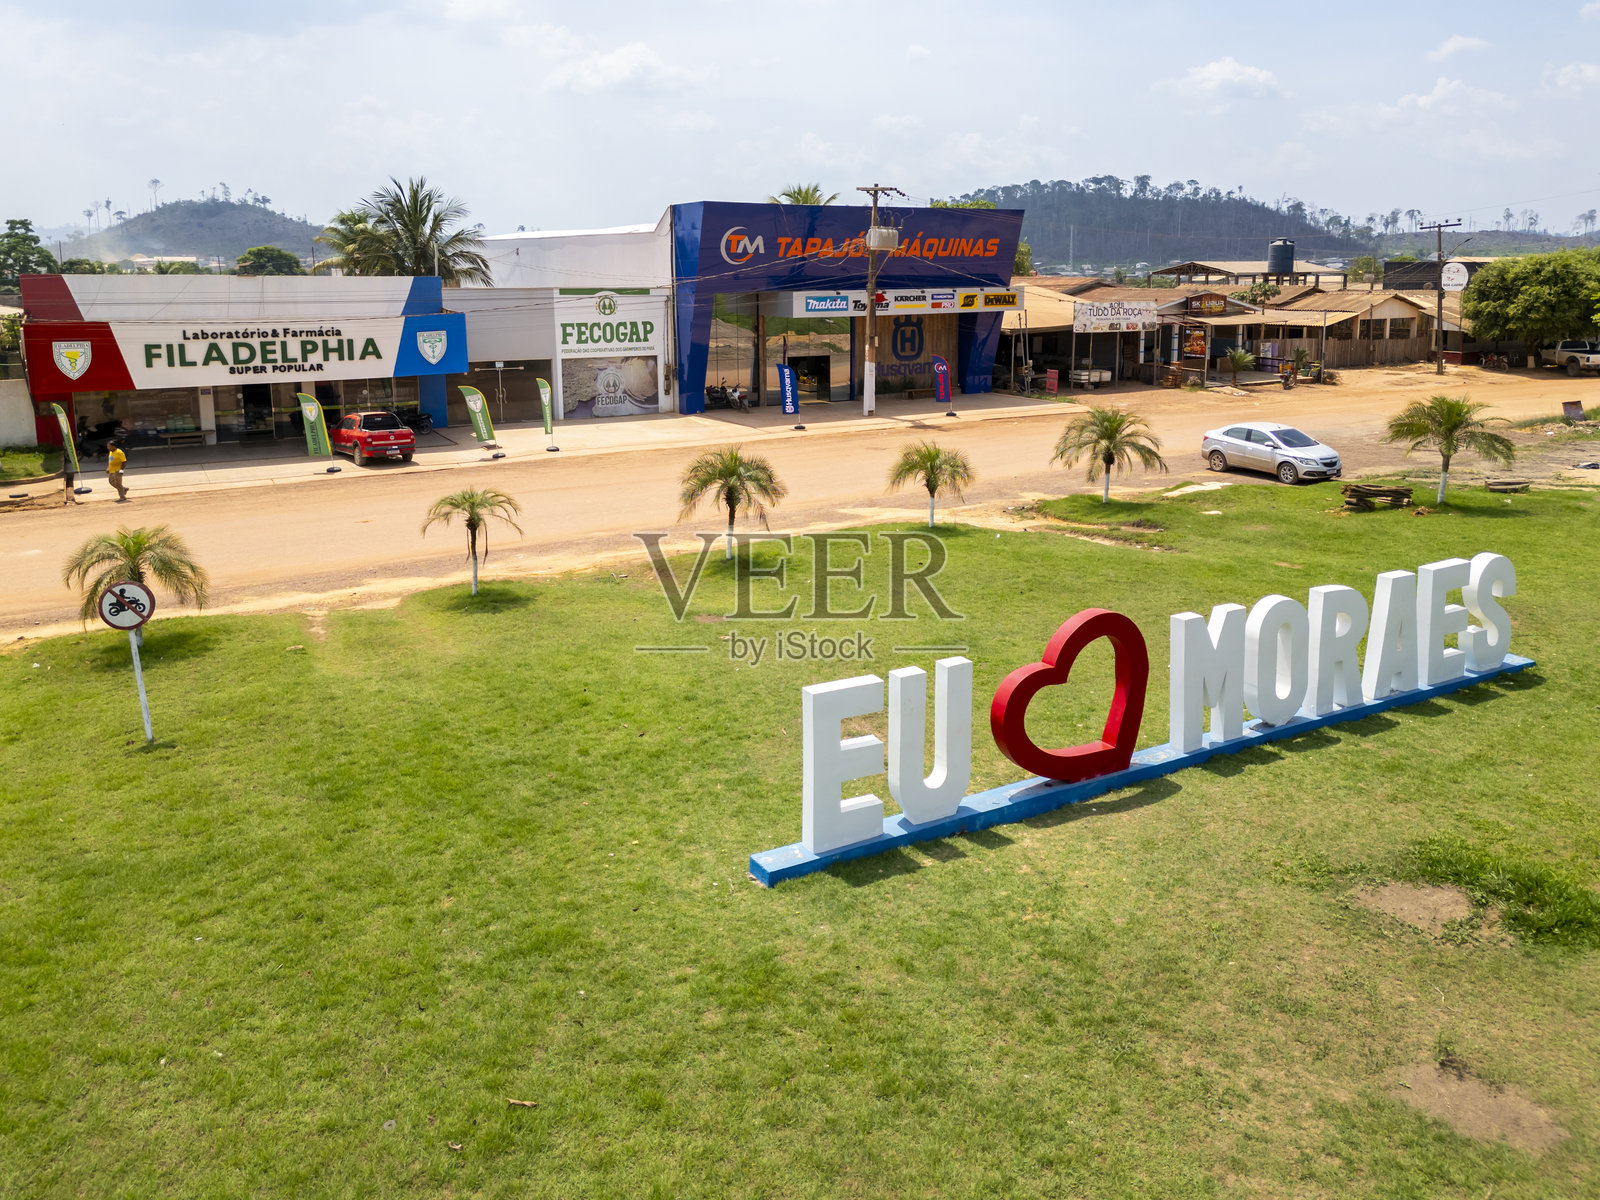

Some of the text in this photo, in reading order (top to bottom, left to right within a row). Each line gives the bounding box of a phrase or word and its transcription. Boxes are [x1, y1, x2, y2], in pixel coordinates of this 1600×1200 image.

[727, 234, 765, 254] TM
[777, 231, 878, 258] TAPAJÓ
[852, 299, 889, 311] Toyma
[182, 326, 342, 341] Laboratório & Farmácia
[560, 320, 655, 345] FECOGAP
[144, 337, 383, 368] FILADELPHIA
[229, 363, 324, 375] SUPER POPULAR
[875, 360, 935, 378] Husqvarn
[596, 395, 628, 406] FECOGAP
[802, 552, 1517, 854] EU MORAES
